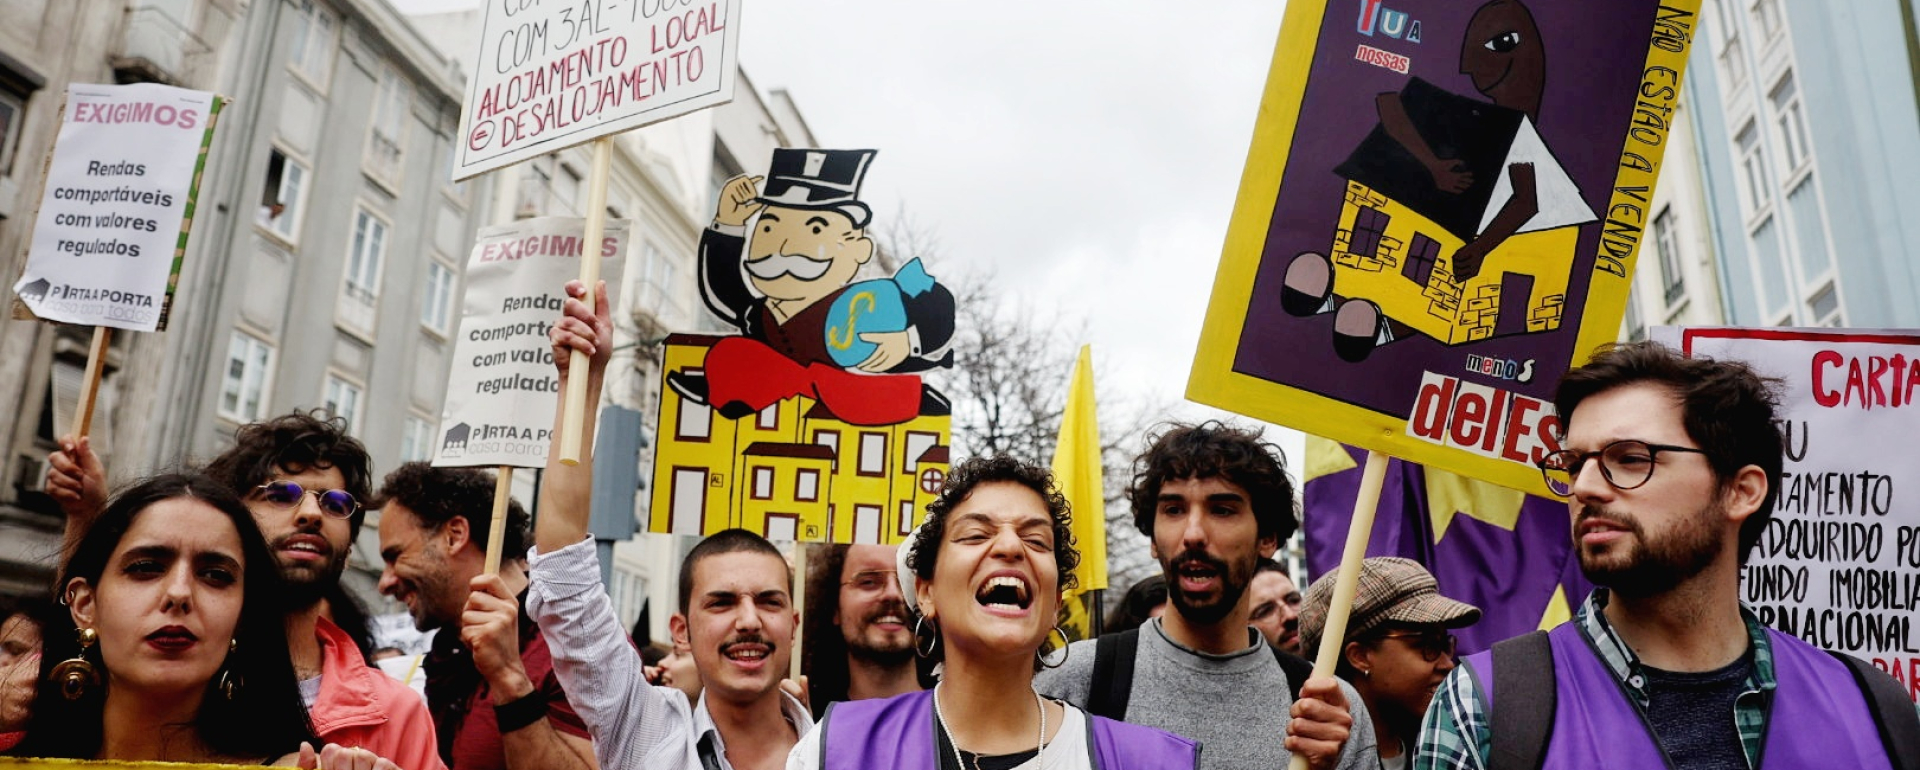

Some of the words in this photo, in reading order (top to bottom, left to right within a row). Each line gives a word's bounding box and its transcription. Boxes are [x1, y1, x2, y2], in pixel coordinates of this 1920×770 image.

[1651, 5, 1694, 53] NÃO
[496, 19, 548, 75] COM
[1357, 46, 1408, 72] nossas
[477, 36, 627, 121] ALOJAMENTO
[651, 2, 724, 54] LOCAL
[500, 45, 704, 148] DESALOJAMENTO
[73, 102, 198, 129] EXIGIMOS
[87, 160, 146, 176] Rendas
[54, 185, 173, 207] comportáveis
[55, 213, 91, 228] com
[95, 212, 158, 232] valores
[1595, 186, 1649, 278] VENDA
[57, 238, 141, 257] regulados
[100, 289, 152, 308] PORTA
[502, 293, 566, 314] Renda
[469, 320, 553, 342] comport
[472, 350, 506, 368] com
[511, 347, 554, 365] valo
[476, 373, 559, 394] regulado
[521, 428, 532, 440] A
[1778, 470, 1893, 518] TAMENTO
[1897, 525, 1920, 568] PO
[1752, 605, 1919, 653] RNACIONAL
